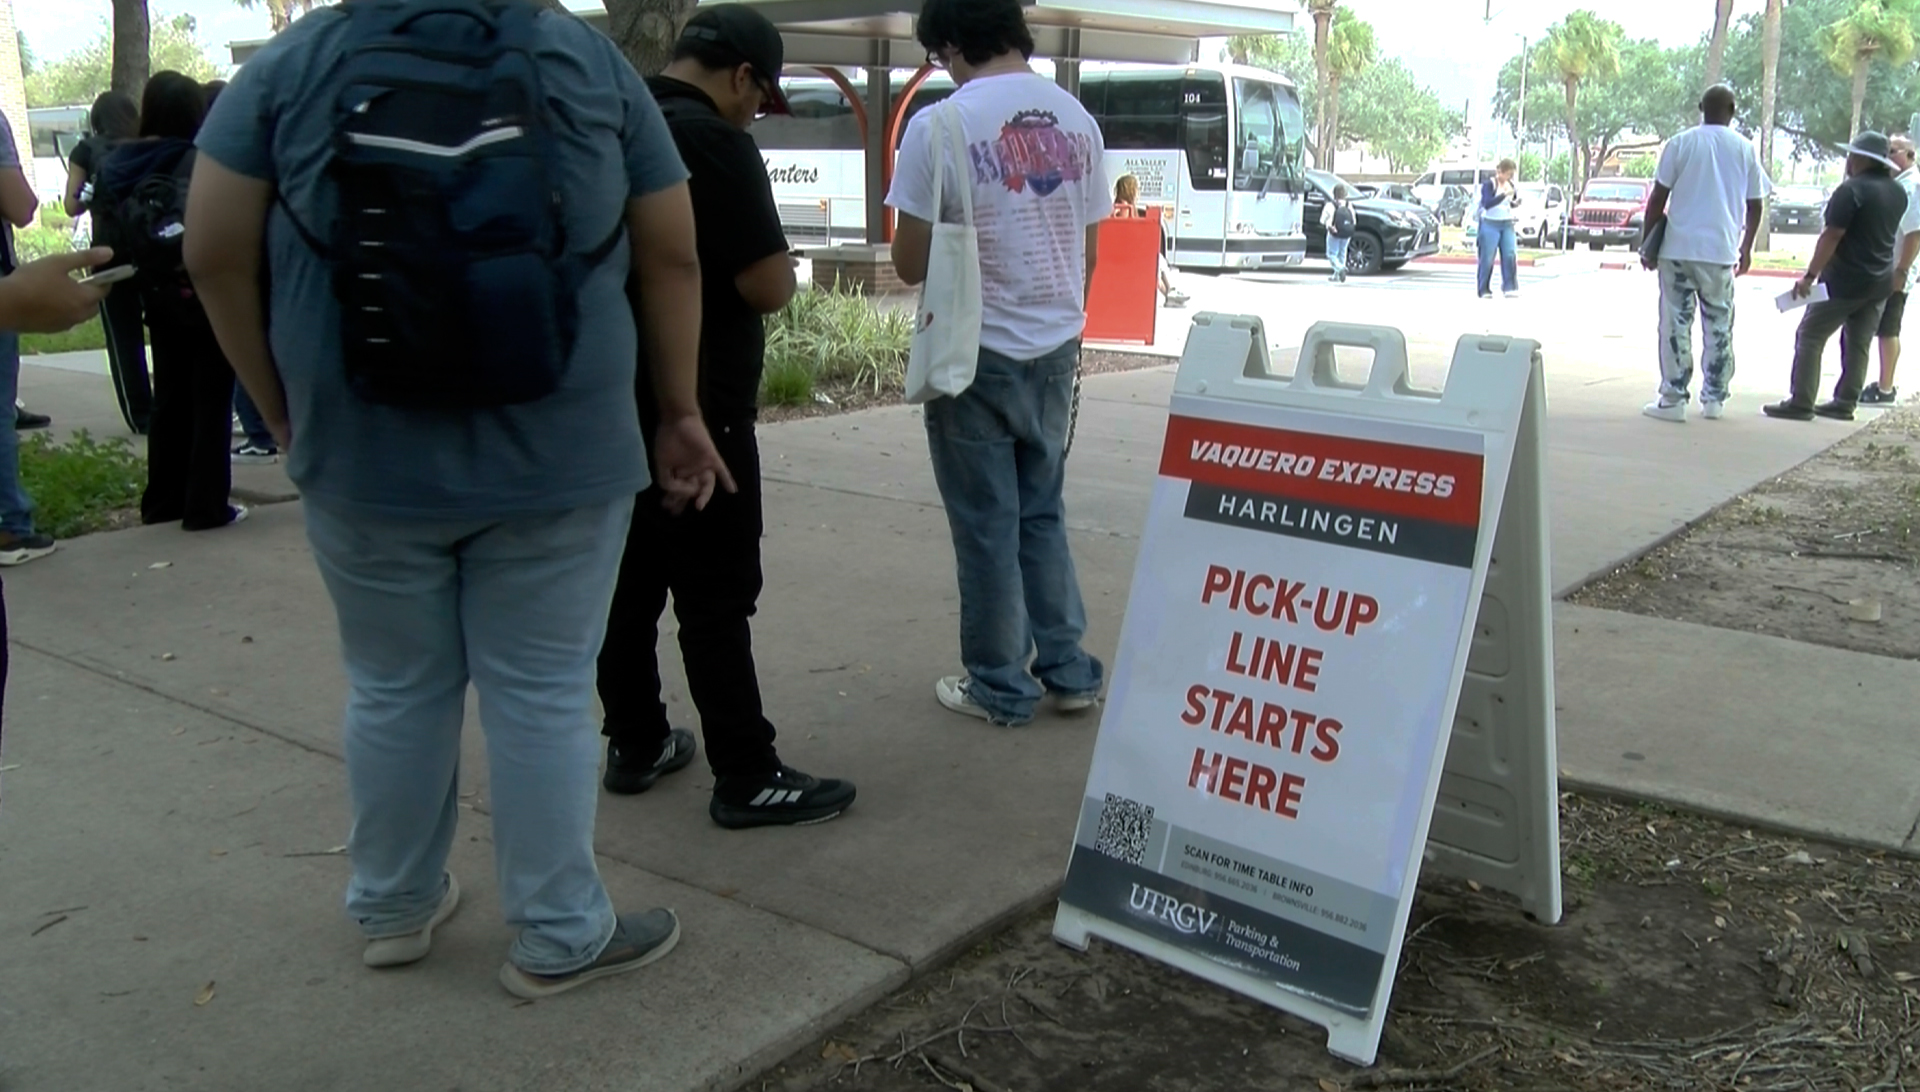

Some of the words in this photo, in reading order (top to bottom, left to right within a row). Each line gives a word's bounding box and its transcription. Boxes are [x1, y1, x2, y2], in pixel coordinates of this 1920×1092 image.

[1184, 93, 1201, 104] 104
[764, 158, 819, 184] arters
[1190, 440, 1316, 476] VAQUERO
[1317, 459, 1455, 497] EXPRESS
[1218, 494, 1398, 544] HARLINGEN
[1201, 564, 1379, 636] PICK-UP
[1225, 631, 1324, 692] LINE
[1180, 684, 1344, 762] STARTS
[1188, 747, 1306, 819] HERE
[1184, 844, 1210, 862] SCAN
[1210, 854, 1231, 869] FOR
[1233, 861, 1256, 878] TIME
[1258, 868, 1288, 888] TABLE
[1288, 880, 1314, 897] INFO
[1129, 882, 1217, 935] UTRGV
[1227, 920, 1268, 946] Parking
[1269, 935, 1280, 949] &
[1225, 933, 1301, 972] Transportation
